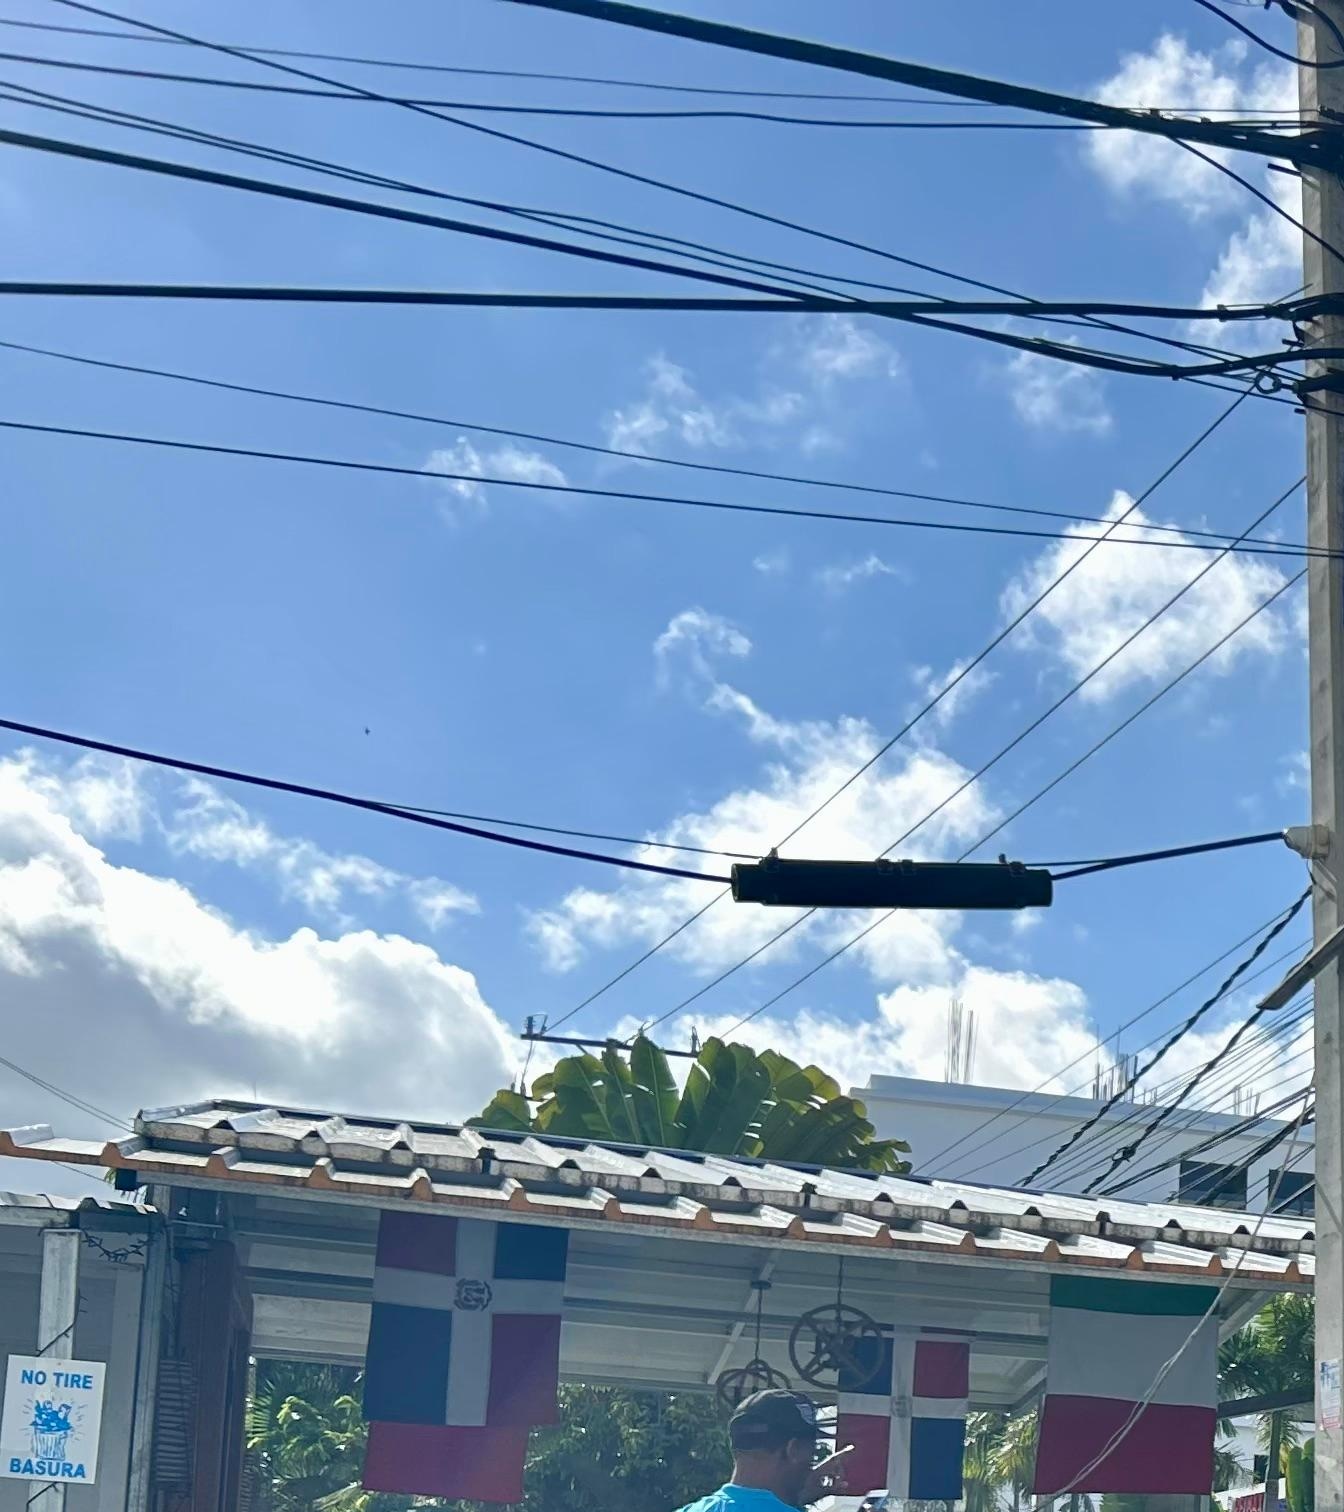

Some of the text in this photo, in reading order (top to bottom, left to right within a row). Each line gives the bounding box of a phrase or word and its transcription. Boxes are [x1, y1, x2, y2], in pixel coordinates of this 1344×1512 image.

[21, 1369, 94, 1390] NO TIRE
[9, 1457, 86, 1479] BASURA
